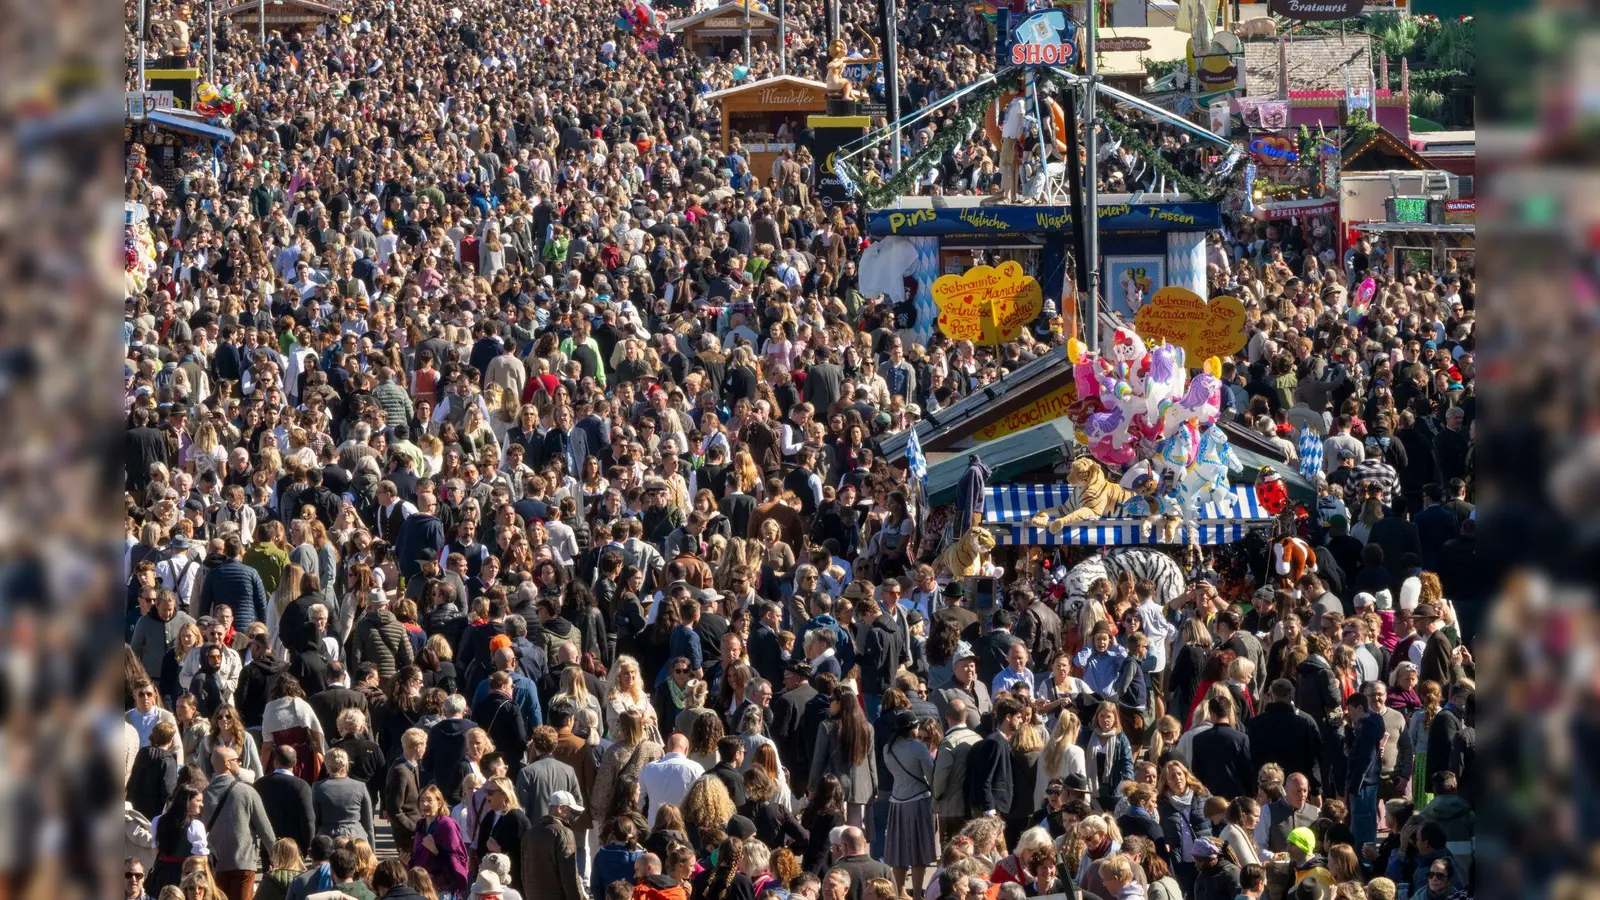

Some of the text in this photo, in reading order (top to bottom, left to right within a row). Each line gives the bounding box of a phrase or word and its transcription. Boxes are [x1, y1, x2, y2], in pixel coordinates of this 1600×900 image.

[1288, 0, 1347, 13] Bratwurst
[1012, 43, 1072, 64] SHOP
[843, 67, 861, 78] WC
[758, 87, 815, 105] Mandelfee
[889, 208, 937, 233] Pins
[959, 207, 1010, 230] Halstücher
[1148, 206, 1195, 225] Tassen
[940, 274, 998, 295] Gebrannte
[982, 281, 1034, 299] Mandeln
[944, 303, 991, 317] Erdnüsse
[1154, 295, 1203, 310] Gebrannte
[1143, 307, 1205, 319] Macadamia
[950, 319, 980, 334] Para
[1138, 321, 1187, 340] Walnüsse
[1200, 325, 1231, 340] Hasel
